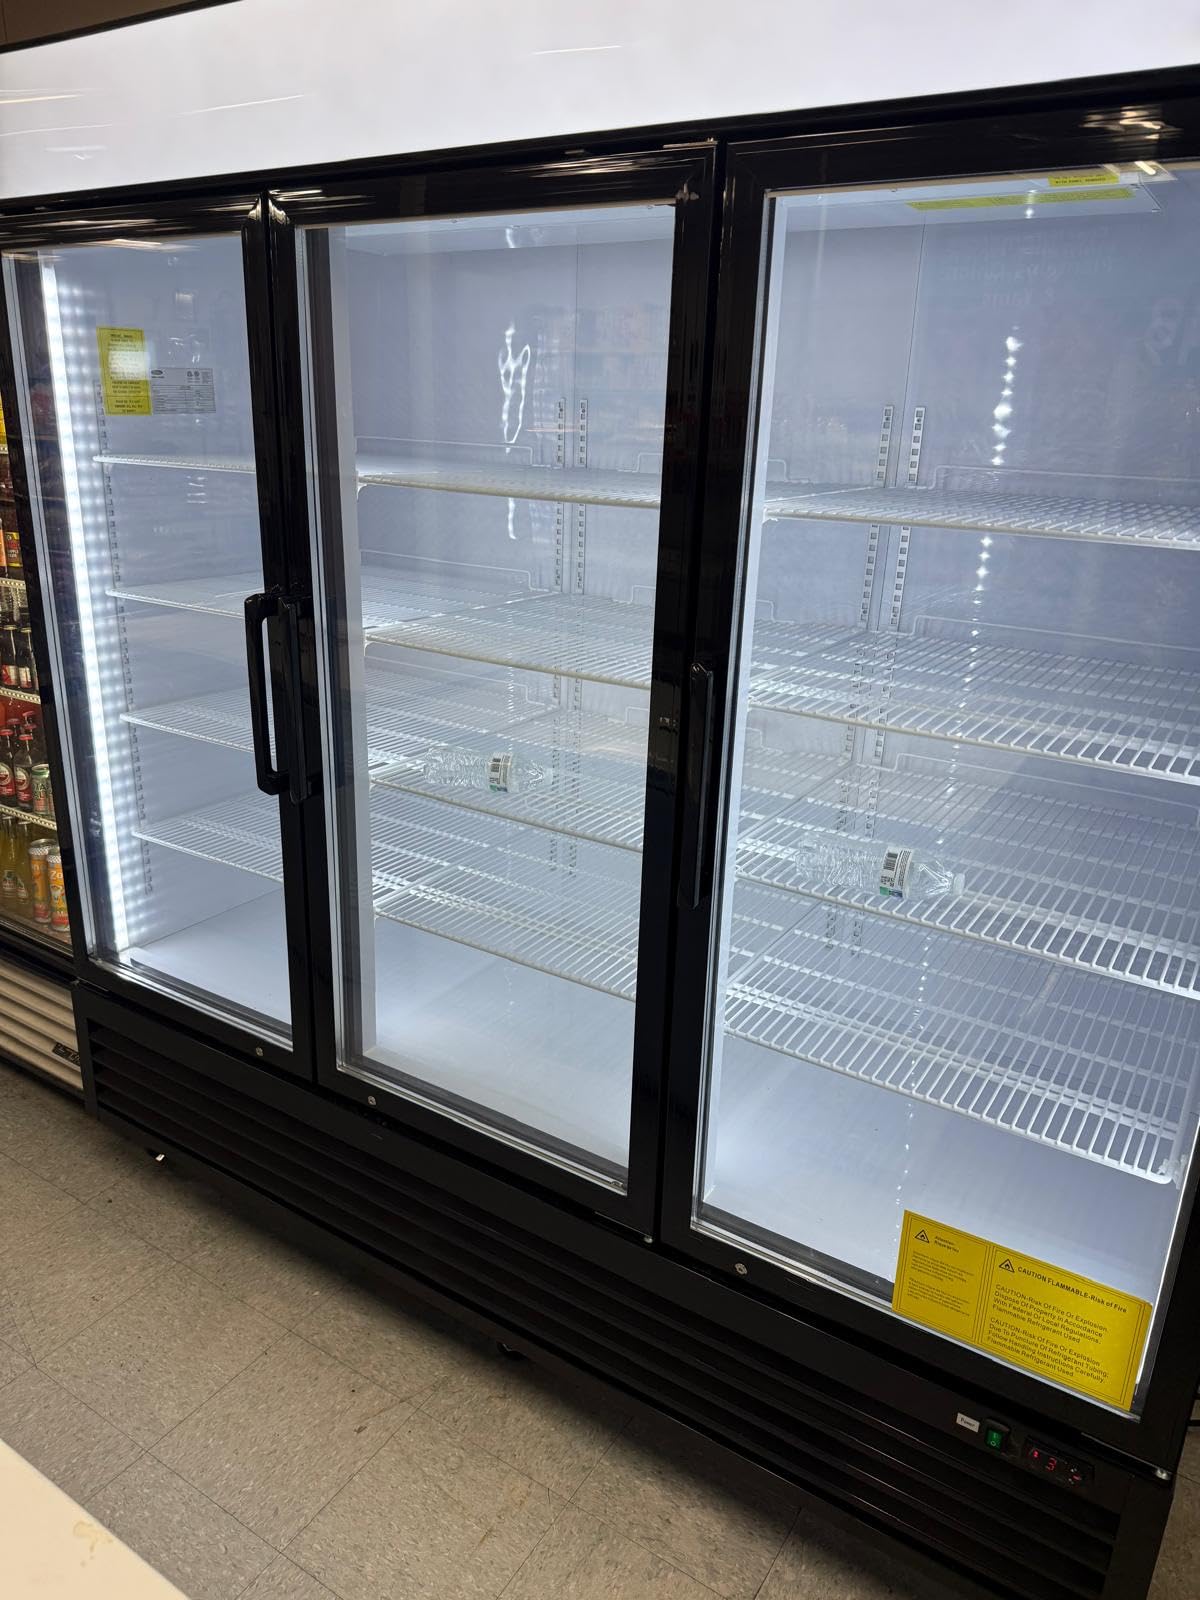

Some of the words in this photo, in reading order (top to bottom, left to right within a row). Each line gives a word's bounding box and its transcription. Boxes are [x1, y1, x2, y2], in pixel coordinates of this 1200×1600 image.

[995, 1283, 1041, 1306] CAUTION-Risk
[1042, 1302, 1051, 1310] Of
[1051, 1305, 1064, 1315] Fire
[1065, 1311, 1074, 1319] Or
[1017, 1266, 1046, 1282] CAUTION
[1047, 1277, 1105, 1304] FLAMMABLE-Risk
[1105, 1300, 1113, 1308] of
[1113, 1303, 1126, 1313] Fire
[992, 1303, 1025, 1320] Flammable
[1027, 1317, 1062, 1336] Refrigerant
[1063, 1332, 1080, 1343] Used
[993, 1296, 1007, 1306] With
[1008, 1302, 1032, 1316] Federal
[1042, 1316, 1058, 1327] Local
[994, 1290, 1019, 1304] Dispose
[1029, 1303, 1055, 1319] Property
[1064, 1318, 1102, 1338] Accordance
[990, 1316, 1035, 1339] CAUTION-Risk
[1036, 1335, 1044, 1343] Of
[1045, 1339, 1058, 1349] Fire
[1059, 1345, 1067, 1353] Or
[1010, 1332, 1038, 1347] Puncture
[1048, 1347, 1084, 1367] Refrigerant
[987, 1336, 1019, 1354] Flammable
[1021, 1350, 1055, 1370] Refrigerant
[1057, 1365, 1073, 1377] Used
[1009, 1338, 1035, 1354] Handling
[1036, 1350, 1073, 1370] Instructions
